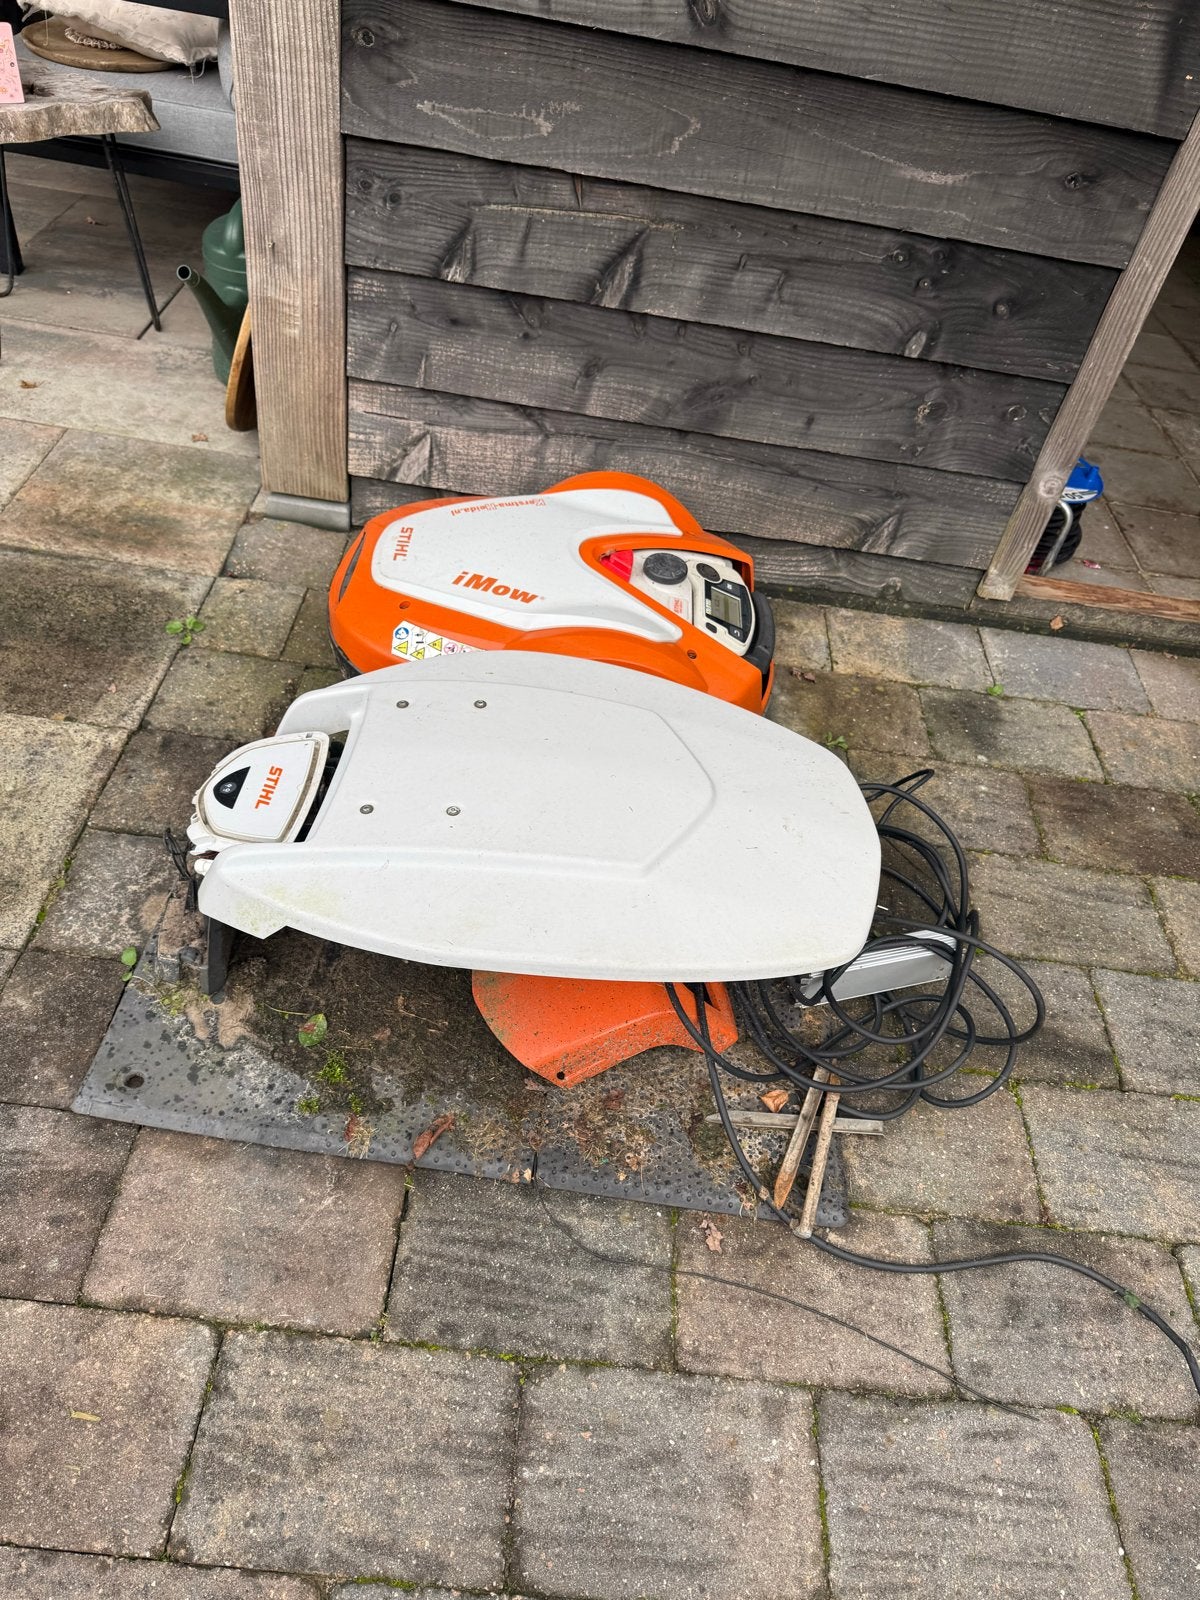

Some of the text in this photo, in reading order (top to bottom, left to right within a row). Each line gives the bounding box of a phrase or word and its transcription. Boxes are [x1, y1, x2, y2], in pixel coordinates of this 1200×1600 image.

[393, 526, 413, 561] STIHL
[452, 571, 537, 604] iMow
[254, 765, 284, 810] STIHL
